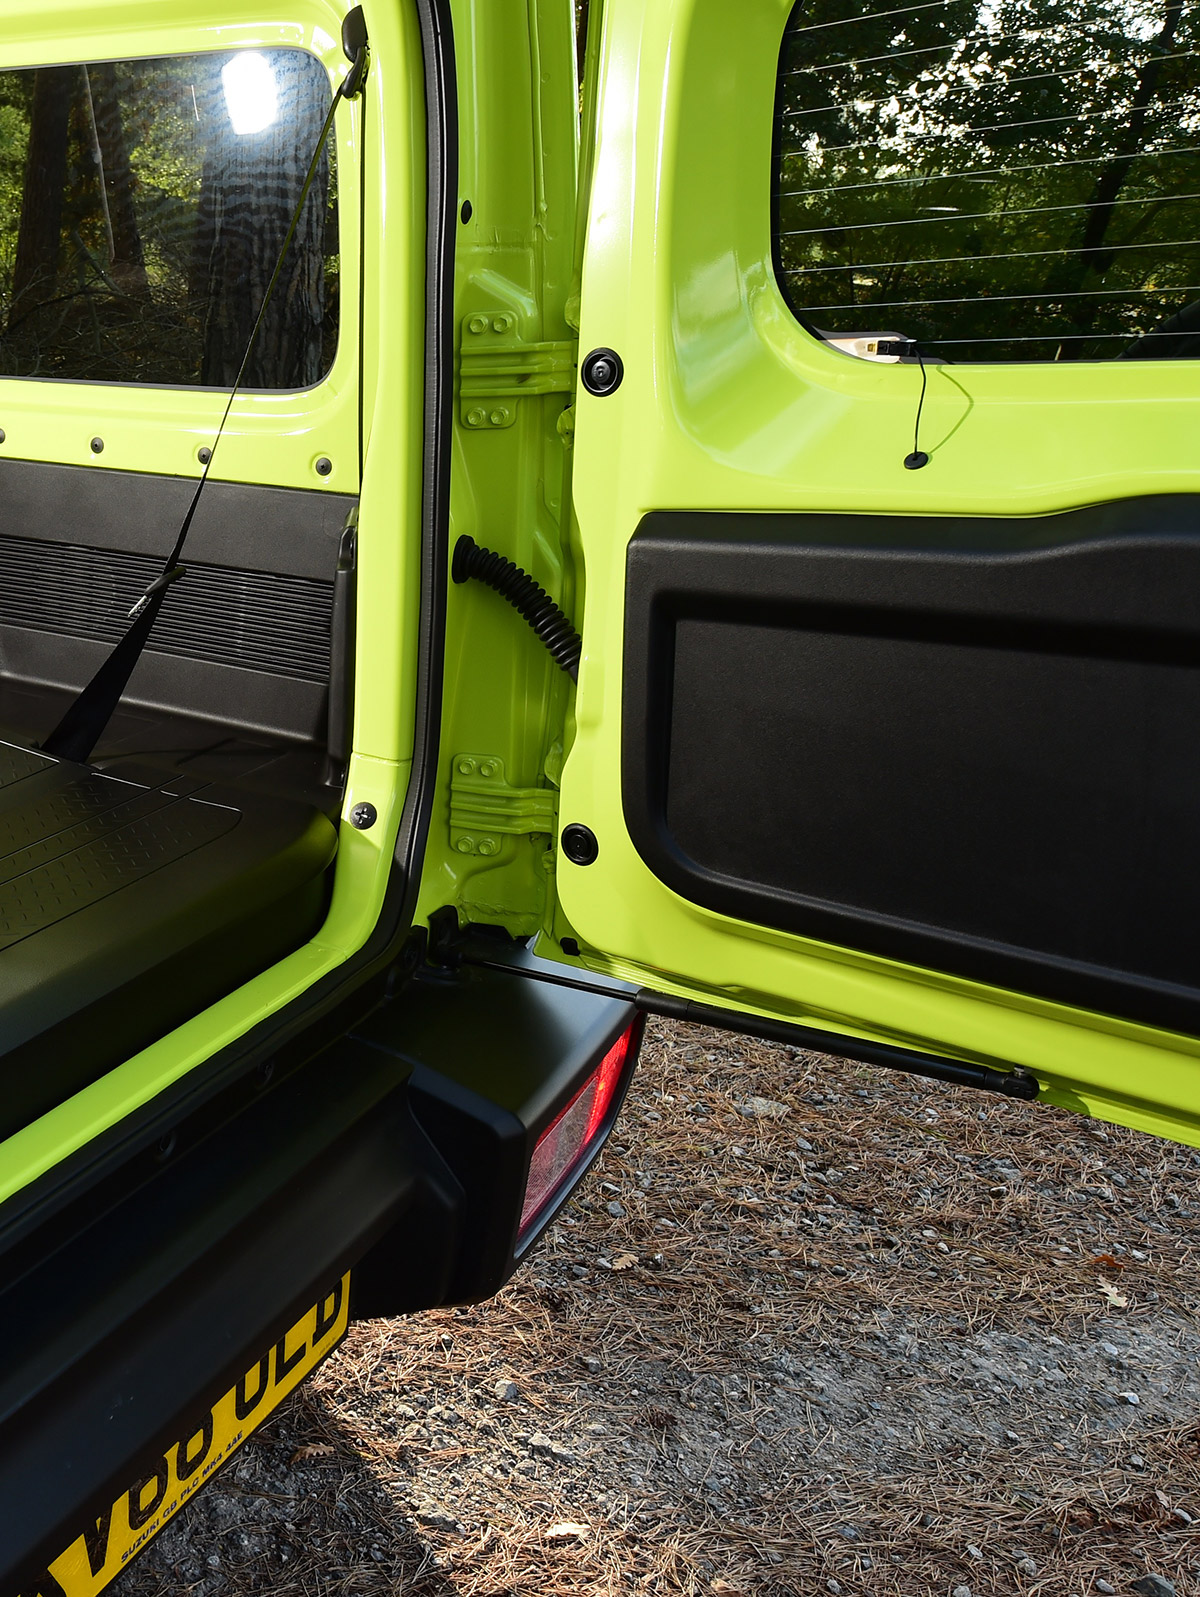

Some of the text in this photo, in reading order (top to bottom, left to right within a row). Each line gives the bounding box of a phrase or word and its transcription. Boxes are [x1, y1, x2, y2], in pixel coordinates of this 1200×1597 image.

[121, 1518, 160, 1563] SUZUKI
[163, 1500, 177, 1519] GB
[180, 1477, 199, 1500] PLC
[202, 1453, 222, 1477] MK4
